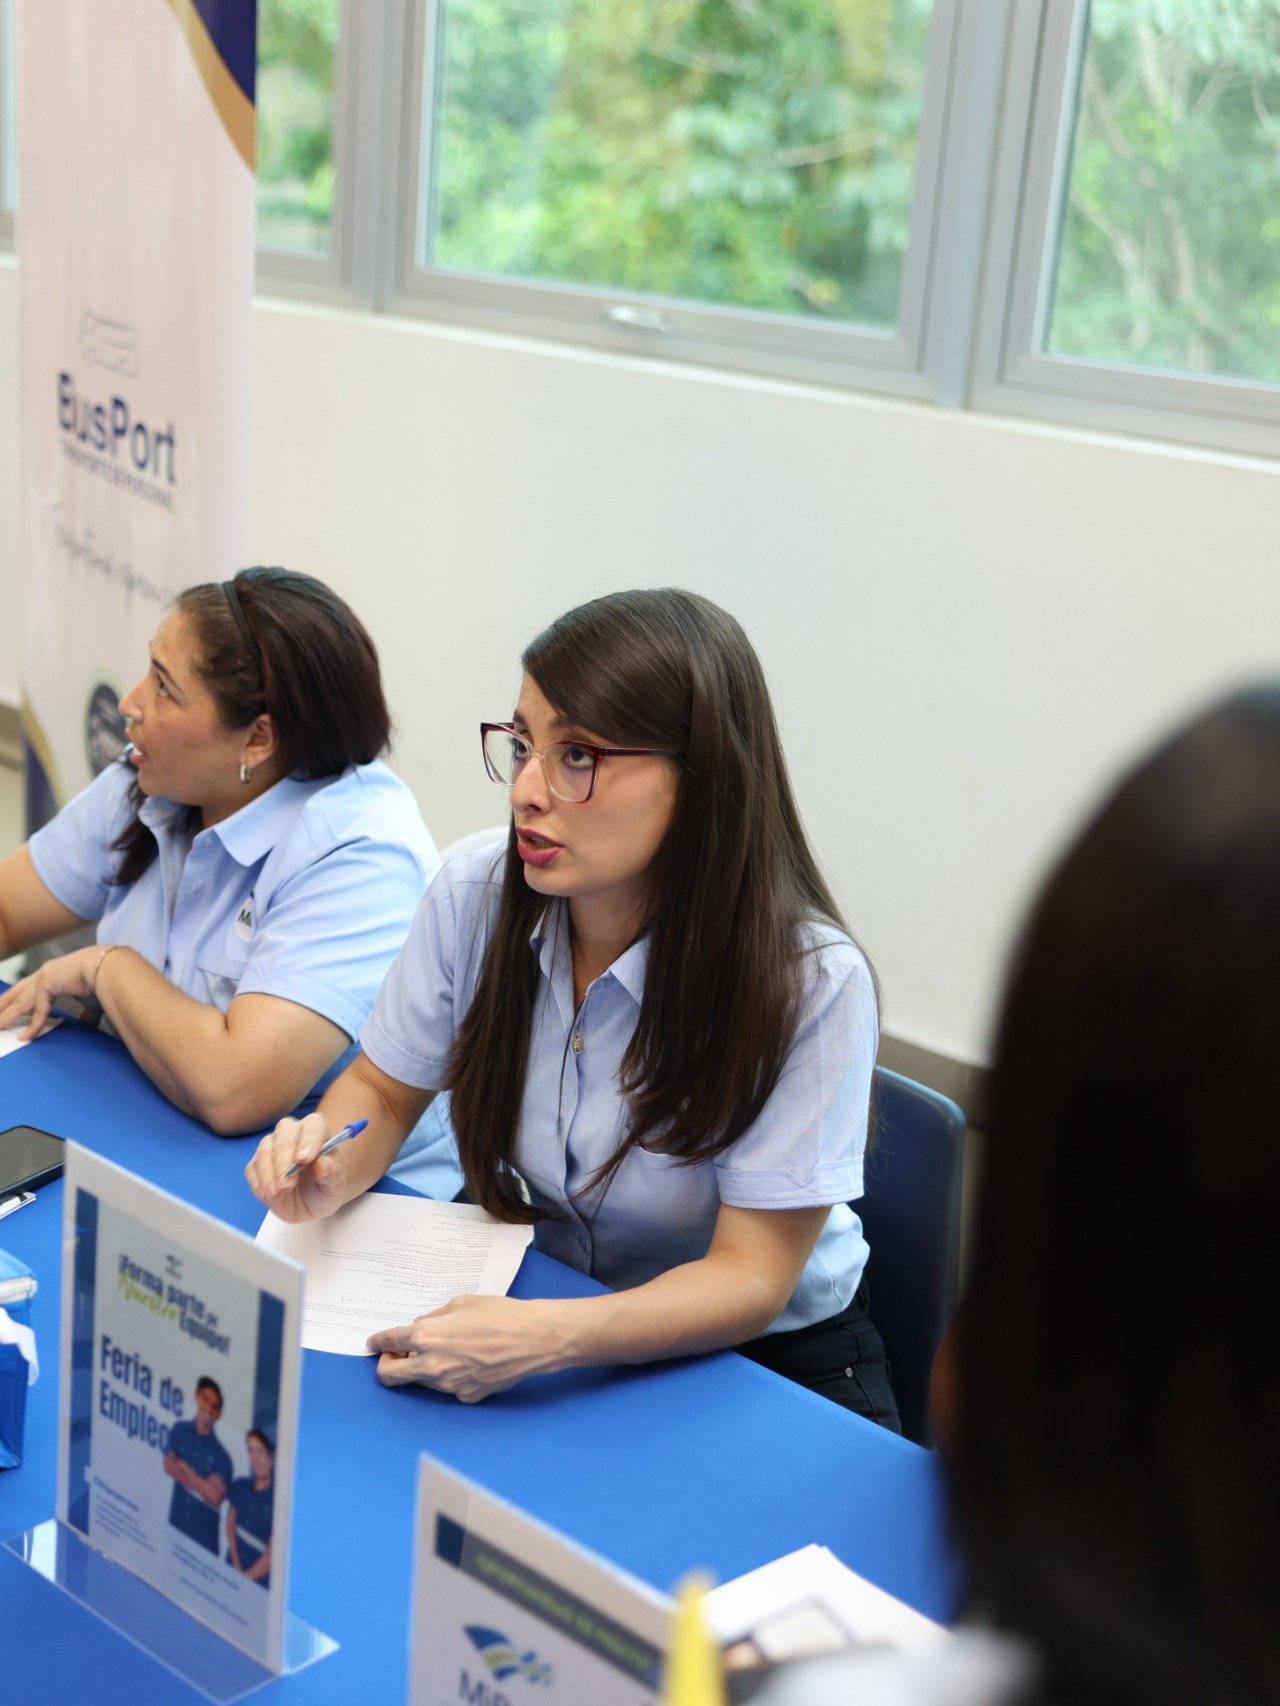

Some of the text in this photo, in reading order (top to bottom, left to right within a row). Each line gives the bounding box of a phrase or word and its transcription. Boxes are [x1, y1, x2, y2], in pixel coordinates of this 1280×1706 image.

[167, 1284, 205, 1320] parte
[101, 1333, 185, 1418] Feria de
[99, 1379, 170, 1455] Empleo
